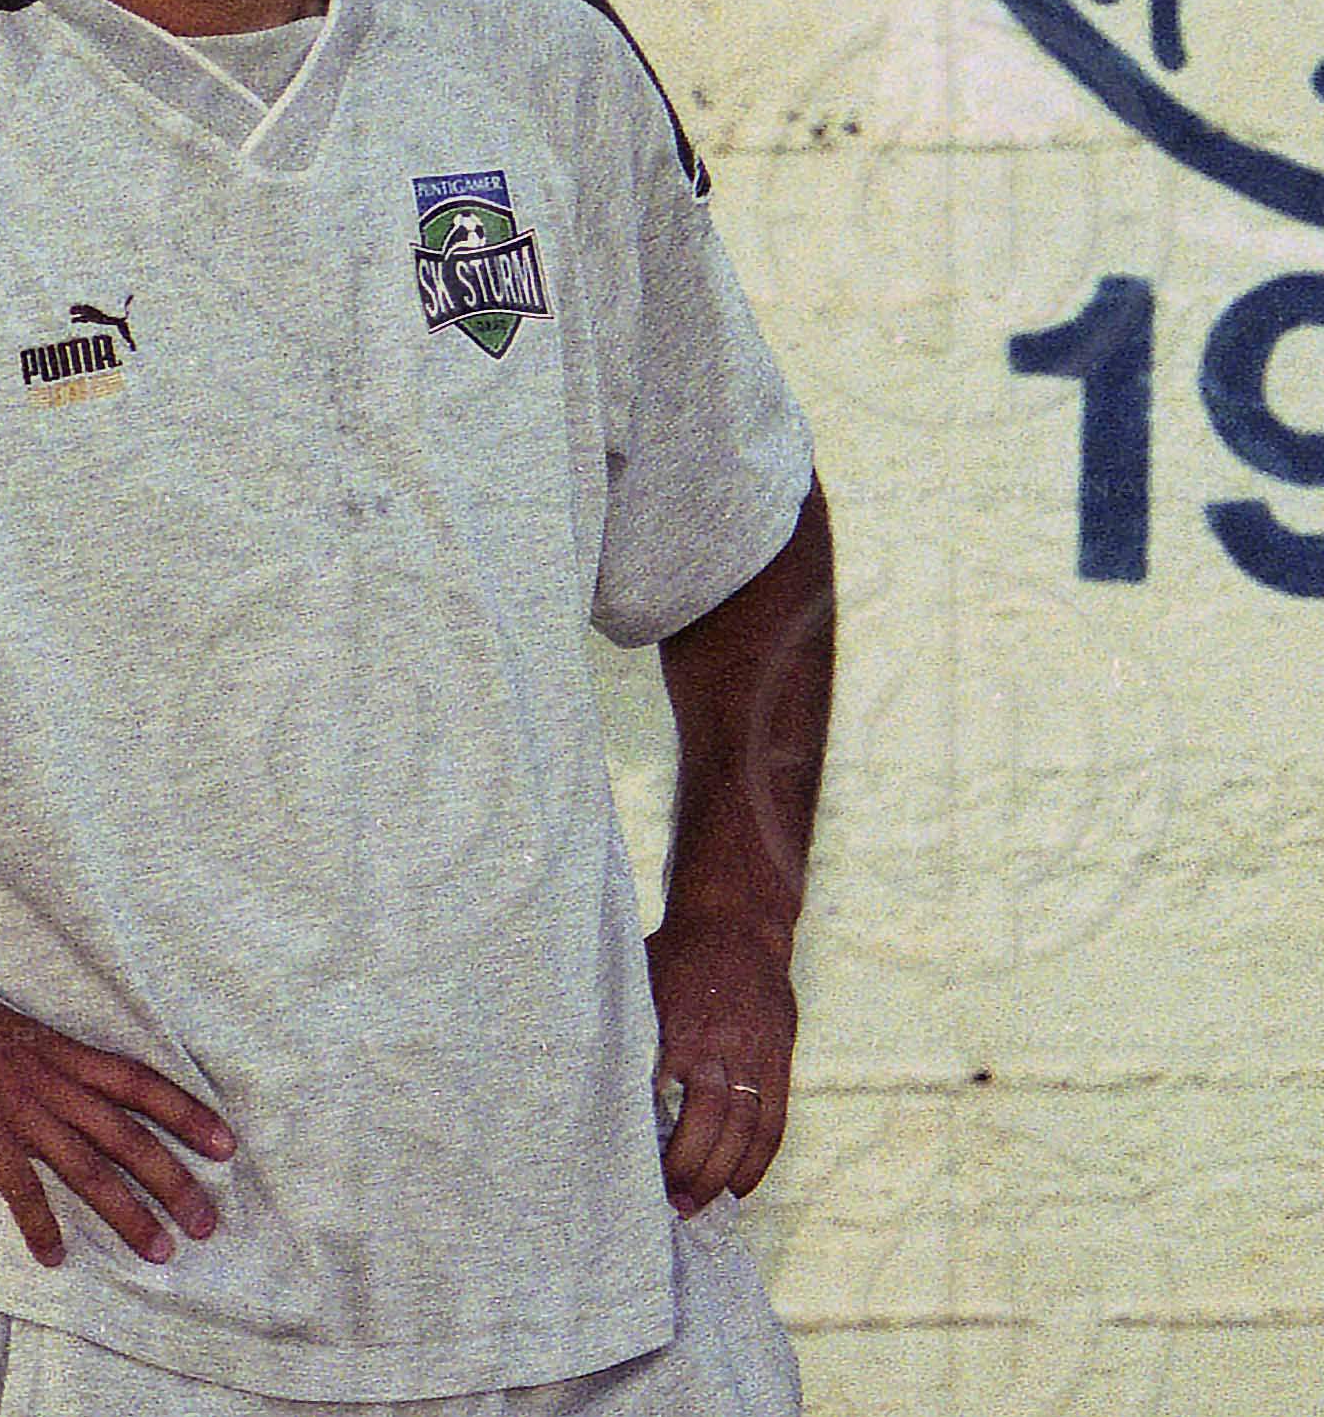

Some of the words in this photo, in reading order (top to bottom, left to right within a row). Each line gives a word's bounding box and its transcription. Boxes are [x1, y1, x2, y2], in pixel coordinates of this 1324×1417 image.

[418, 257, 456, 318] SK
[455, 244, 541, 308] STURM
[20, 334, 118, 385] PUMA
